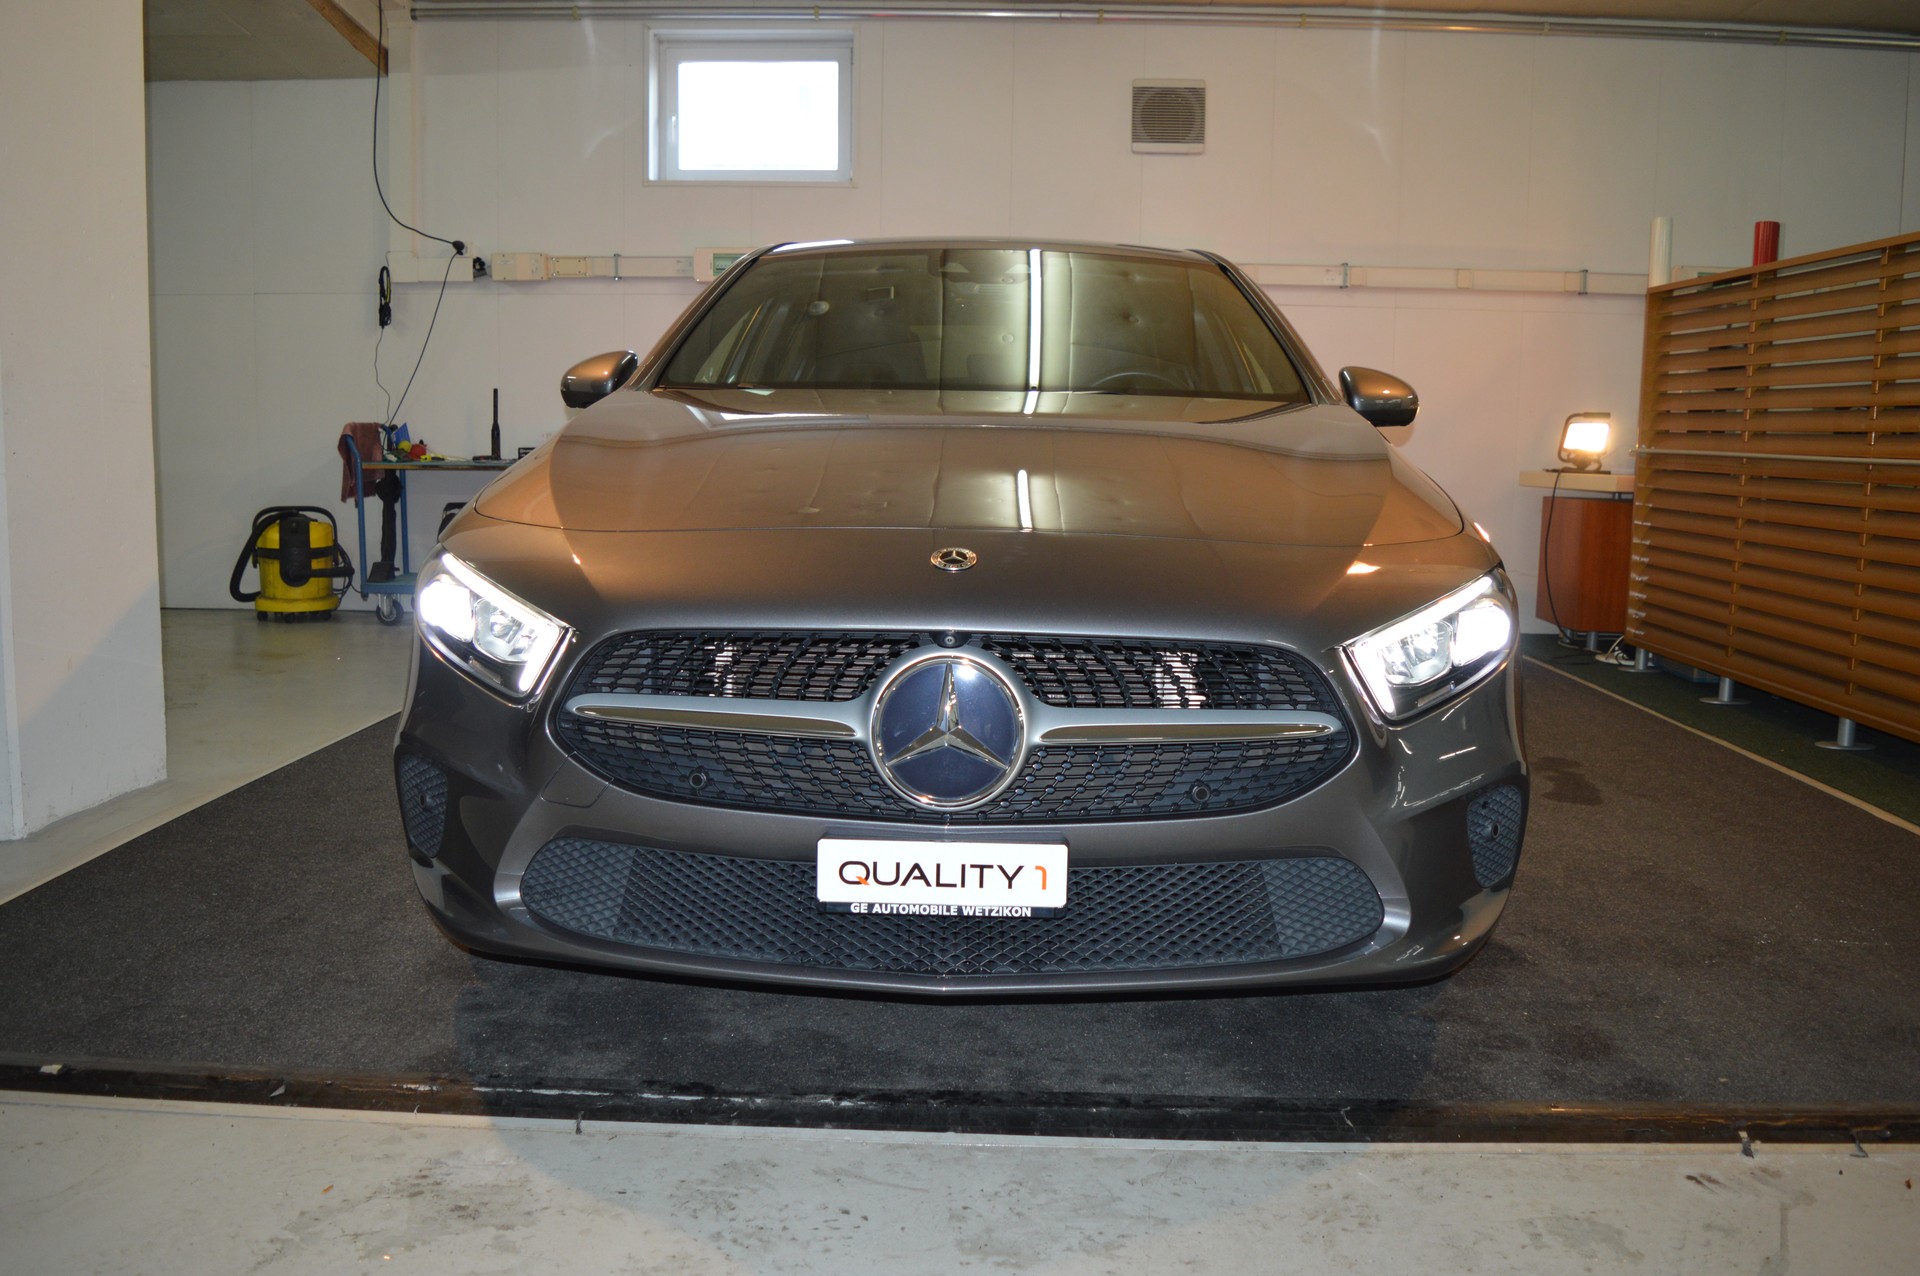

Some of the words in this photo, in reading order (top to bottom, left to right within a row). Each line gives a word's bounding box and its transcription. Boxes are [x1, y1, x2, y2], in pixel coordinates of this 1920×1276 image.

[850, 902, 868, 914] GE
[872, 903, 958, 916] AUTOMOBILE
[962, 905, 1031, 917] WETZIKON
